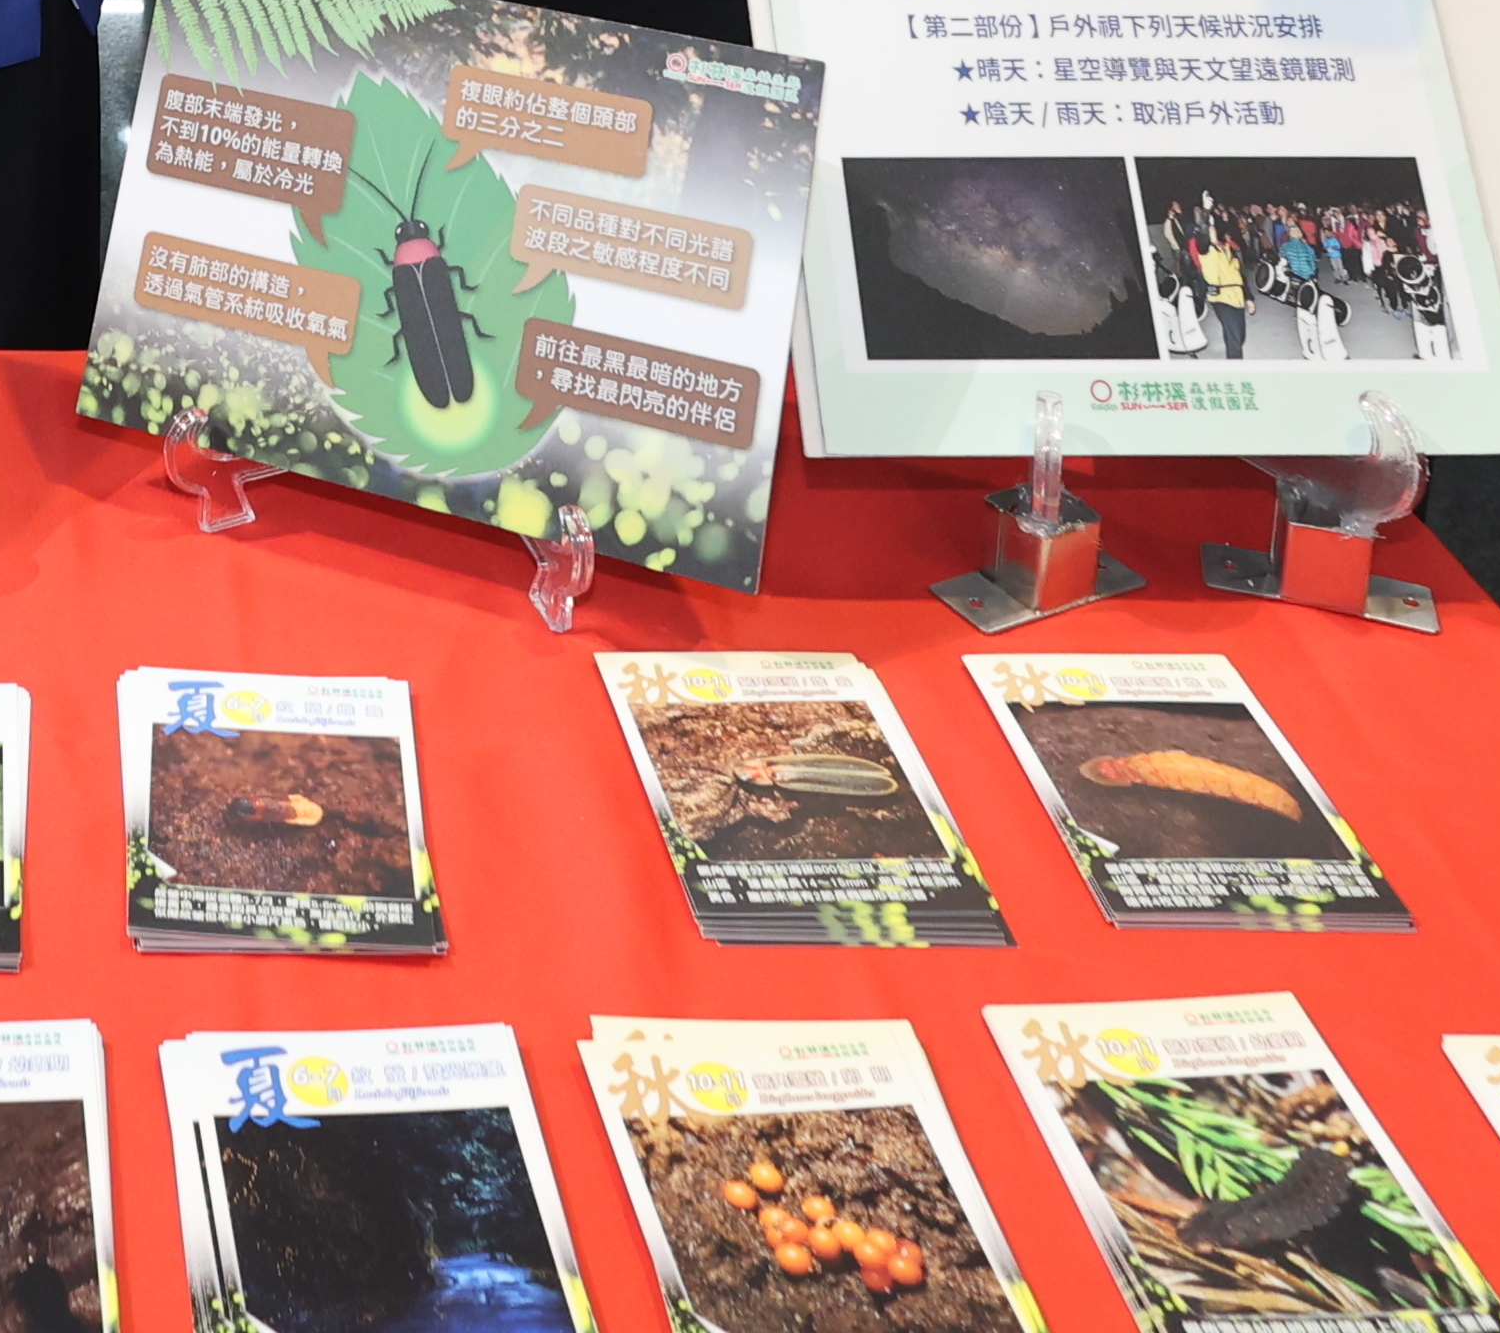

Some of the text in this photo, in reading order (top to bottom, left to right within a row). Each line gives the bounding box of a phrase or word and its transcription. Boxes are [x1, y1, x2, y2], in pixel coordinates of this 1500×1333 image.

[455, 106, 566, 150] 的三分之二
[459, 77, 639, 135] 複眼約佔整個頭部
[159, 113, 344, 176] 不到10%的能量轉換
[524, 226, 731, 294] 波段之敏感程度不同
[527, 197, 736, 264] 不同品種對不同光譜
[143, 269, 349, 344] 透過氣管系統吸收氧氣
[533, 335, 744, 404] 前往最黑最暗的地方
[162, 680, 241, 738] 夏
[618, 661, 706, 715] 秋
[992, 660, 1086, 714] 秋
[218, 1044, 322, 1133] 夏
[1019, 1017, 1126, 1096] 秋
[606, 1051, 720, 1134] 秋
